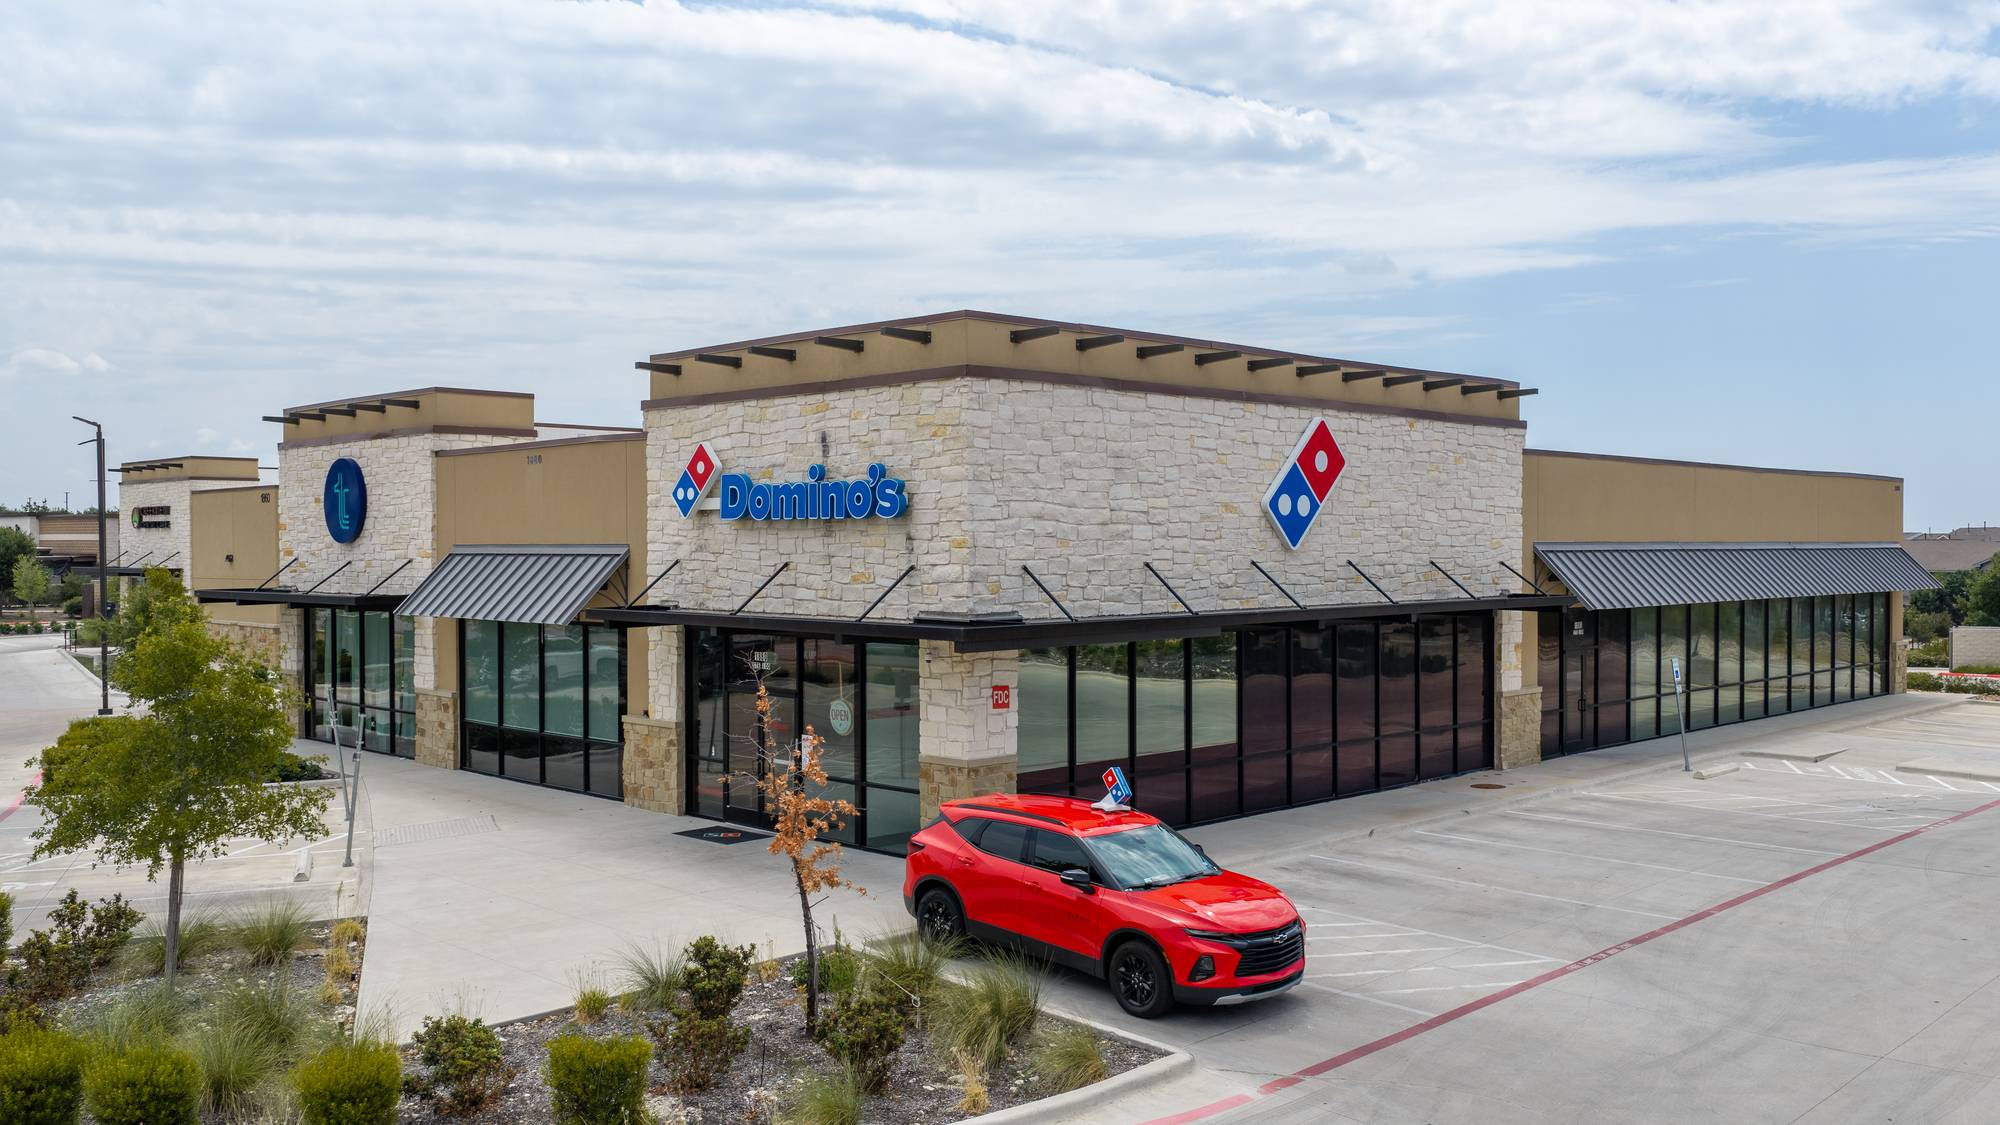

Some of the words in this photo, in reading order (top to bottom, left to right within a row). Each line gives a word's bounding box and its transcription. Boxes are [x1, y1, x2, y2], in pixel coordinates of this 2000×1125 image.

[719, 463, 908, 520] Domino's
[993, 690, 1009, 704] FDC
[831, 709, 849, 722] OPEN
